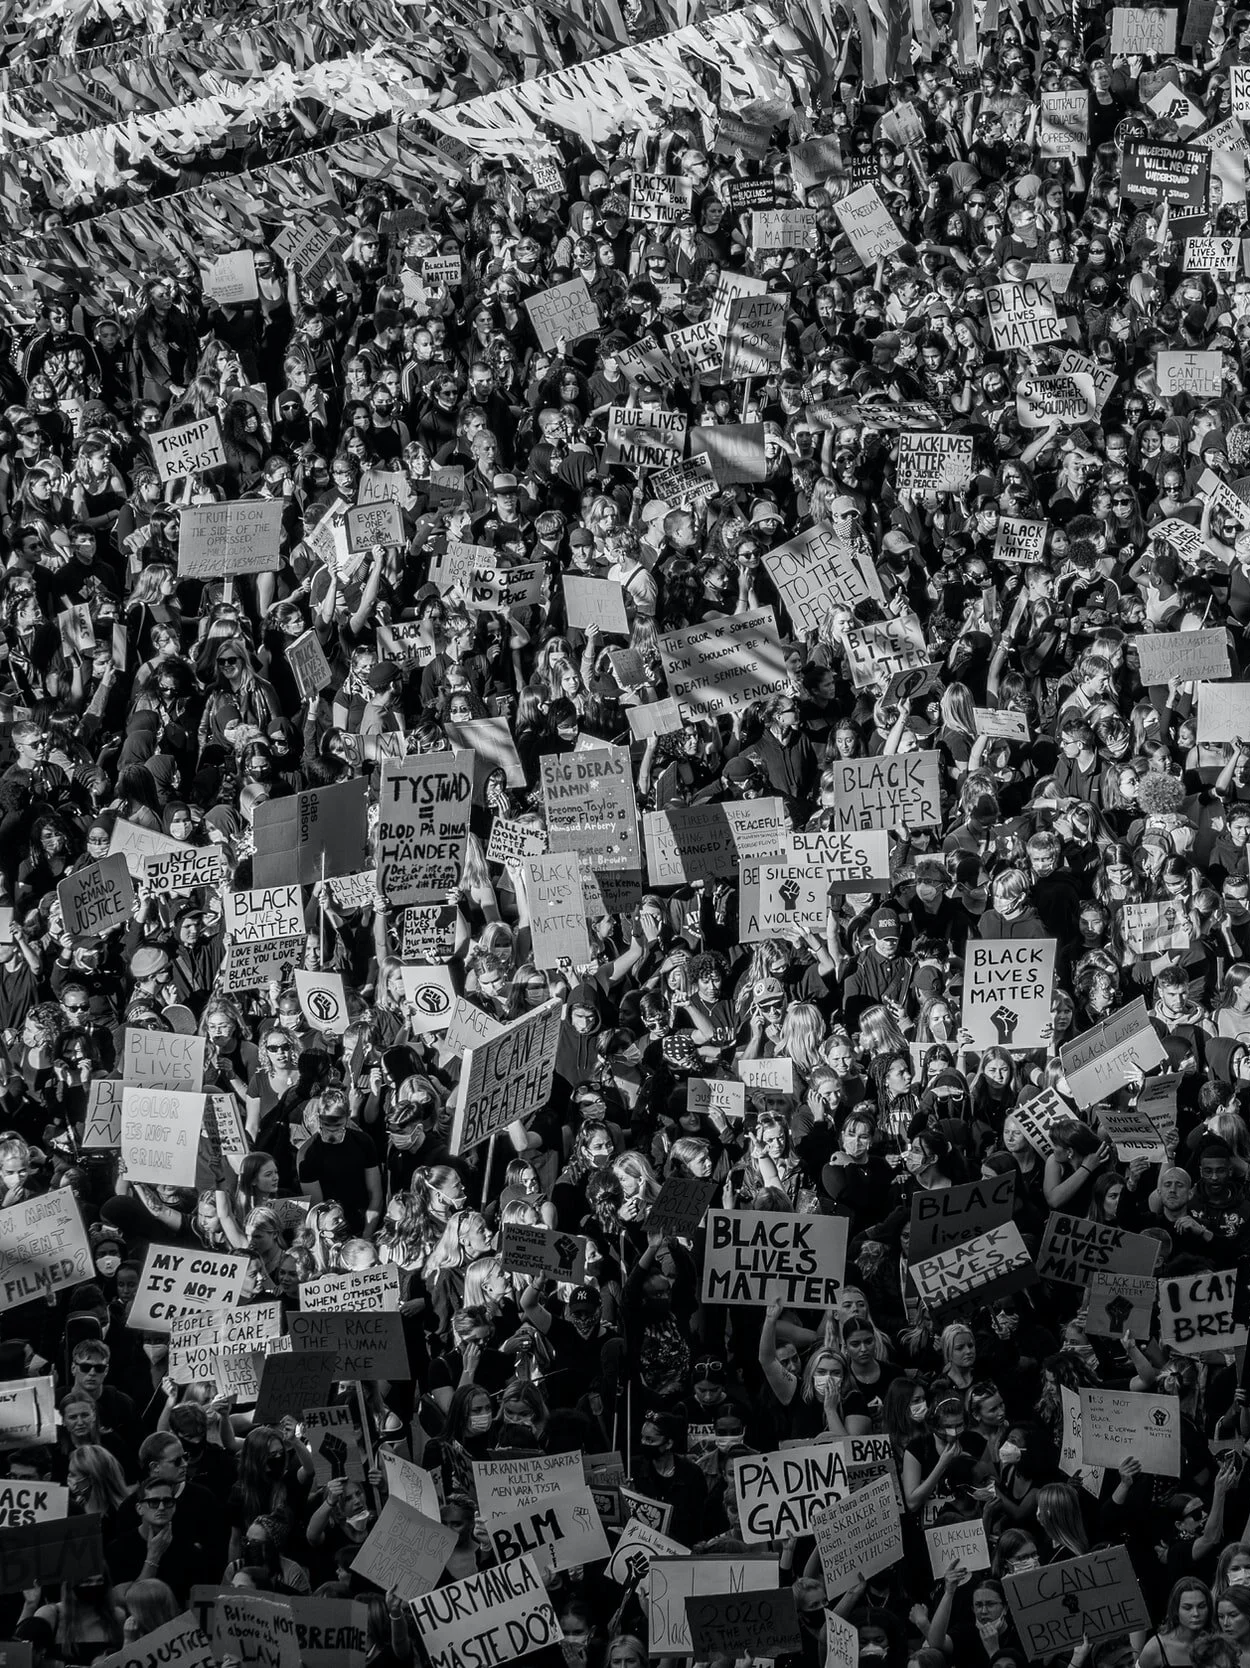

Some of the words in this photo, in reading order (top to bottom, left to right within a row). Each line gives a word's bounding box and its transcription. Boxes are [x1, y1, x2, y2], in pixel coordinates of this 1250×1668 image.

[1233, 102, 1244, 110] NO
[1190, 240, 1214, 249] BLACK
[1192, 248, 1216, 257] LIVES
[1187, 257, 1235, 268] MATTER!!
[987, 282, 1051, 314] BLACK
[1008, 310, 1035, 322] LIVES
[994, 318, 1059, 347] MATTER
[614, 410, 646, 427] BLUE
[650, 412, 686, 432] LIVES
[158, 424, 209, 452] TRUMP
[900, 436, 937, 453] BLACK
[940, 438, 972, 453] LIVES
[166, 448, 219, 475] RASIST
[620, 445, 682, 467] MURDER
[898, 452, 946, 470] MATTER
[898, 470, 912, 479] NO
[914, 470, 940, 479] JUSTICE
[898, 480, 912, 488] NO
[914, 480, 938, 488] PEACE
[1003, 522, 1043, 539] BLACK
[1006, 536, 1038, 548] LIVES
[766, 532, 841, 578] POWER
[999, 546, 1039, 561] MATTER
[780, 576, 809, 604] TO
[808, 554, 847, 586] THE
[662, 637, 685, 652] THE
[688, 632, 713, 646] COLOR
[716, 628, 725, 638] OF
[669, 658, 692, 673] SKIN
[746, 638, 760, 650] BE
[764, 637, 770, 645] A
[676, 676, 710, 696] DEATH
[714, 663, 759, 684] SENTENCE
[677, 698, 723, 721] ENOUGH
[728, 693, 740, 705] IS
[744, 678, 792, 701] ENOUGH!
[380, 823, 415, 839] BLOD
[420, 820, 436, 836] PÅ
[440, 822, 467, 836] DINA
[170, 850, 197, 864] NO
[382, 838, 461, 862] HÄNDER
[148, 856, 217, 876] JUSTICE
[80, 871, 100, 890] WE
[150, 878, 169, 888] NO
[173, 868, 220, 887] PEACE
[74, 880, 115, 908] DEMAND
[234, 887, 298, 916] BLACK
[72, 891, 125, 934] JUSTICE
[234, 919, 303, 942] MATTER.
[231, 945, 251, 958] LOVE
[254, 942, 278, 954] BLACK
[280, 938, 306, 949] PEOPLE
[974, 948, 1043, 967] BLACK
[231, 958, 250, 968] LIKE
[254, 954, 270, 964] YOU
[273, 951, 296, 962] LOVE
[228, 975, 269, 989] CULTURE
[230, 967, 260, 979] BLACK
[974, 969, 1038, 985] LIVES
[970, 985, 1044, 1005] MATTER
[714, 1217, 813, 1249] BLACK
[152, 1254, 185, 1271] MY
[190, 1260, 238, 1280] COLOR
[734, 1248, 817, 1275] LIVES
[148, 1275, 176, 1293] IS
[184, 1282, 217, 1298] NOT
[222, 1290, 234, 1303] A
[710, 1270, 841, 1304] MATTER
[292, 1318, 335, 1335] ONE
[300, 1336, 330, 1350] THE
[338, 1336, 387, 1350] HUMAN
[336, 1356, 373, 1370] RACE
[739, 1457, 781, 1499] PÅ
[784, 1453, 847, 1494] DINA
[412, 1595, 471, 1645] HUR
